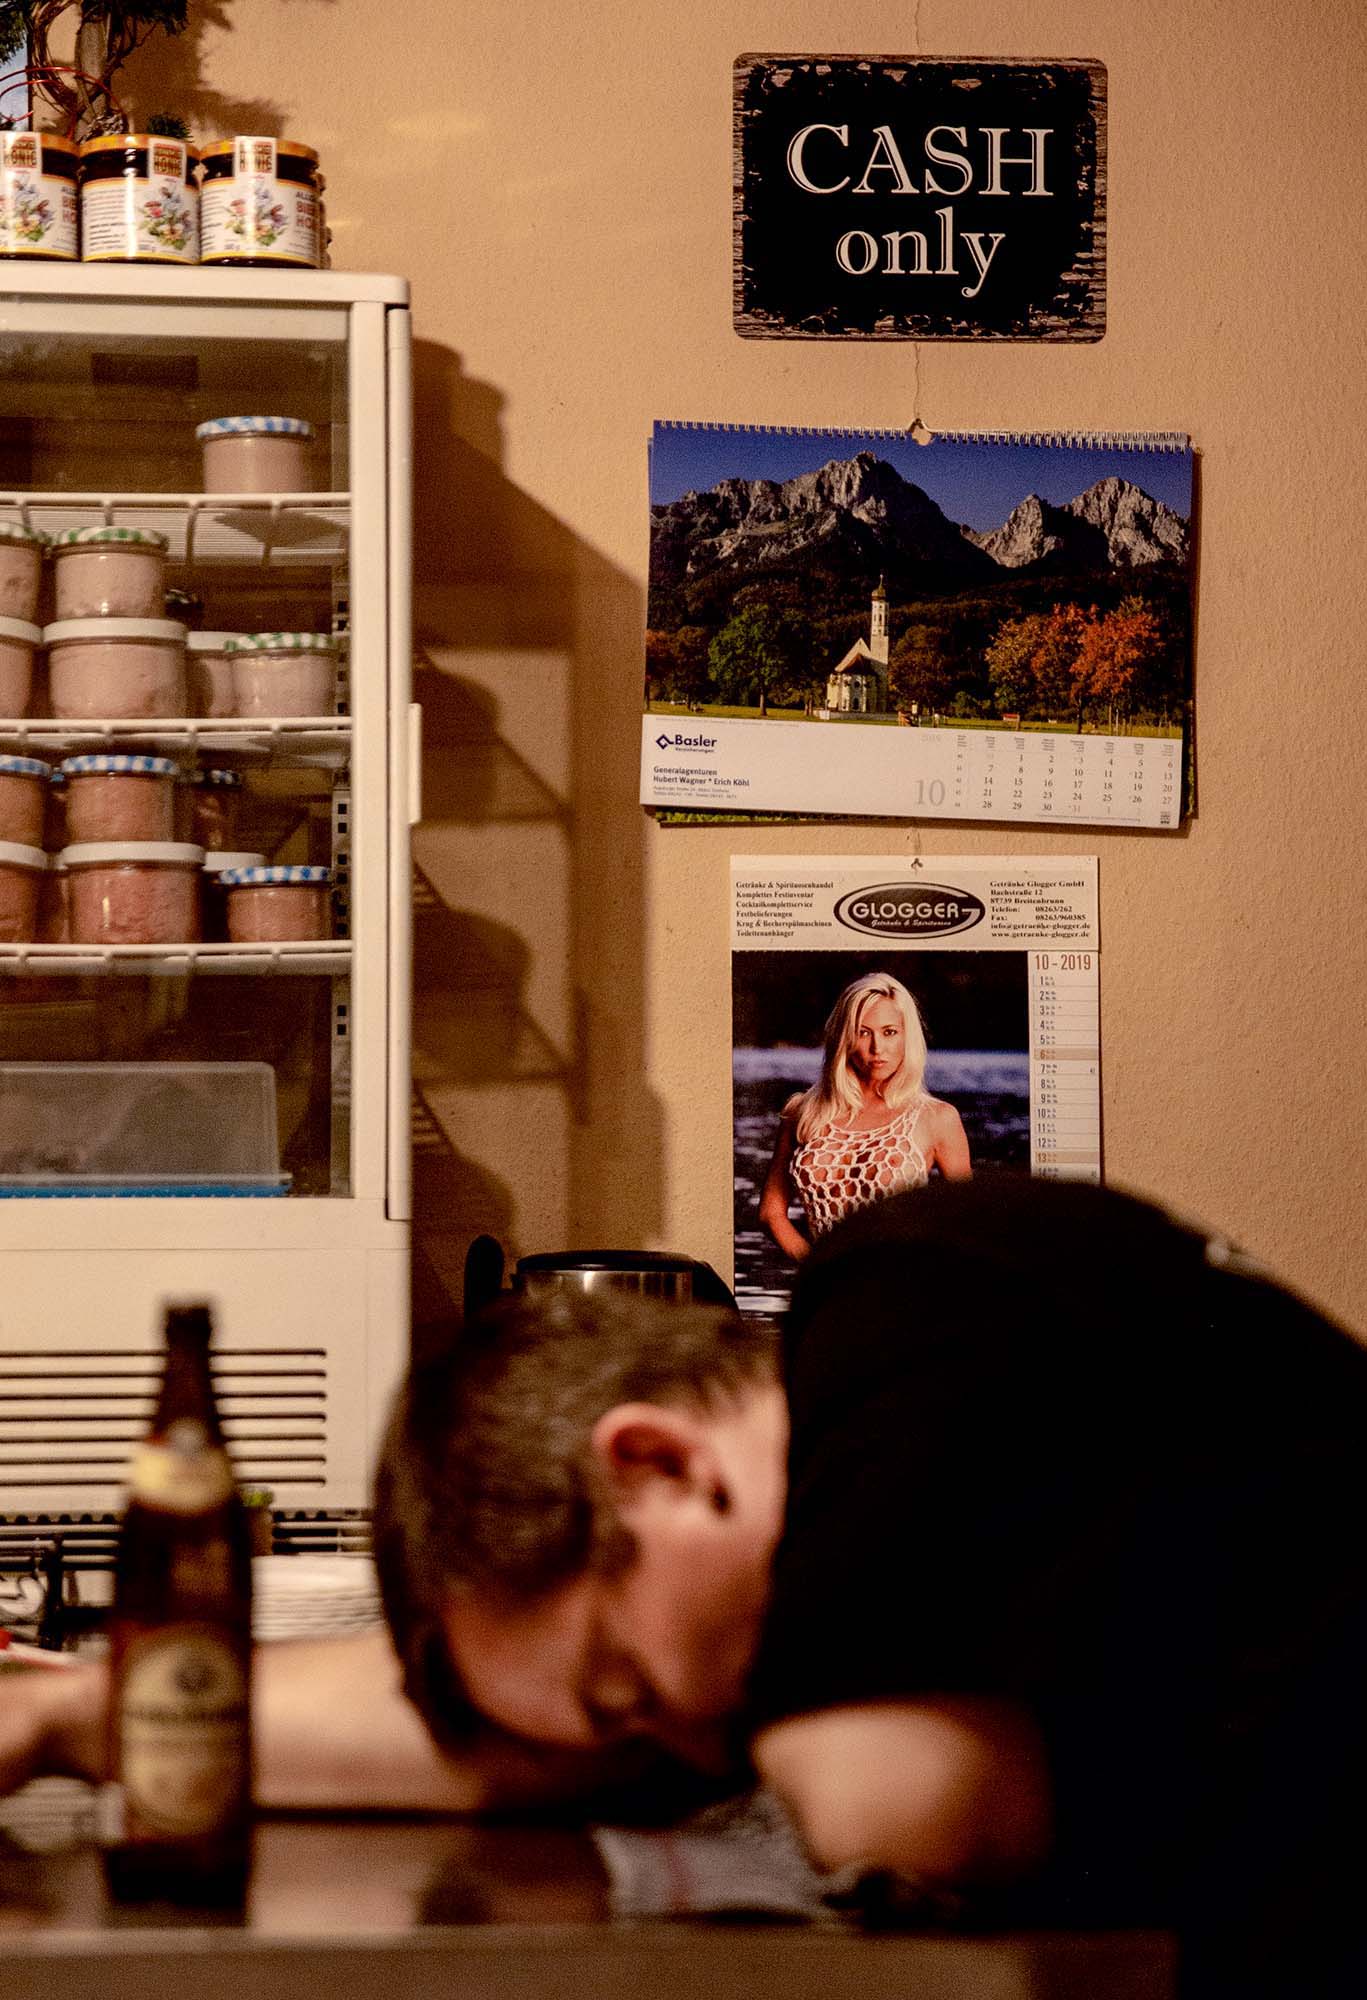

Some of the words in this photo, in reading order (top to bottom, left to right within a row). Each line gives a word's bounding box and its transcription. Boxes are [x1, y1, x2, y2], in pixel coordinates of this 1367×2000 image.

[786, 123, 1054, 196] CASH
[835, 206, 1006, 298] only
[674, 734, 718, 747] Basler
[653, 766, 718, 776] Generalagenturen
[1074, 768, 1084, 777] 10
[1104, 769, 1113, 778] 11
[1133, 771, 1143, 780] 12
[1163, 772, 1173, 781] 13
[653, 775, 678, 784] Hubert
[679, 776, 707, 786] Wagner
[713, 778, 732, 787] Erich
[732, 778, 750, 787] Köhl
[983, 776, 994, 785] 14
[1013, 777, 1023, 787] 15
[1043, 779, 1054, 788] 16
[1073, 780, 1083, 790] 17
[1103, 781, 1113, 791] 18
[1133, 783, 1143, 792] 19
[1162, 784, 1173, 793] 20
[913, 779, 946, 808] 10
[983, 788, 993, 797] 21
[1012, 790, 1023, 799] 22
[1042, 791, 1053, 800] 23
[1072, 792, 1083, 801] 24
[1102, 793, 1113, 803] 25
[1132, 795, 1143, 804] 26
[1161, 796, 1172, 806] 27
[982, 801, 993, 810] 28
[1012, 802, 1023, 811] 29
[1042, 803, 1053, 812] 30
[775, 882, 834, 890] Spirituosenhandel
[1026, 881, 1057, 889] Glogger
[736, 892, 773, 900] Komplettes
[736, 911, 793, 919] Festbelieferungen
[852, 902, 959, 919] GLOGGER
[903, 919, 910, 927] &
[1035, 914, 1087, 922] 08263/960385
[736, 920, 754, 929] Krug
[755, 920, 761, 928] &
[763, 920, 833, 929] Becherspülmaschinen
[990, 923, 1090, 931] info@getraenke-glogger.de
[991, 931, 1089, 939] www.getraenke-glogger.de
[1040, 976, 1044, 986] 1
[1040, 990, 1045, 1001] 2
[1040, 1005, 1045, 1016] 3
[1040, 1020, 1045, 1030] 4
[1040, 1034, 1046, 1045] 5
[1040, 1049, 1046, 1060] 6
[1041, 1064, 1046, 1074] 7
[1041, 1079, 1046, 1089] 8
[1041, 1093, 1046, 1104] 9
[1037, 1108, 1047, 1119] 10
[1037, 1123, 1046, 1133] 11
[1038, 1138, 1047, 1148] 12
[1038, 1153, 1047, 1163] 13
